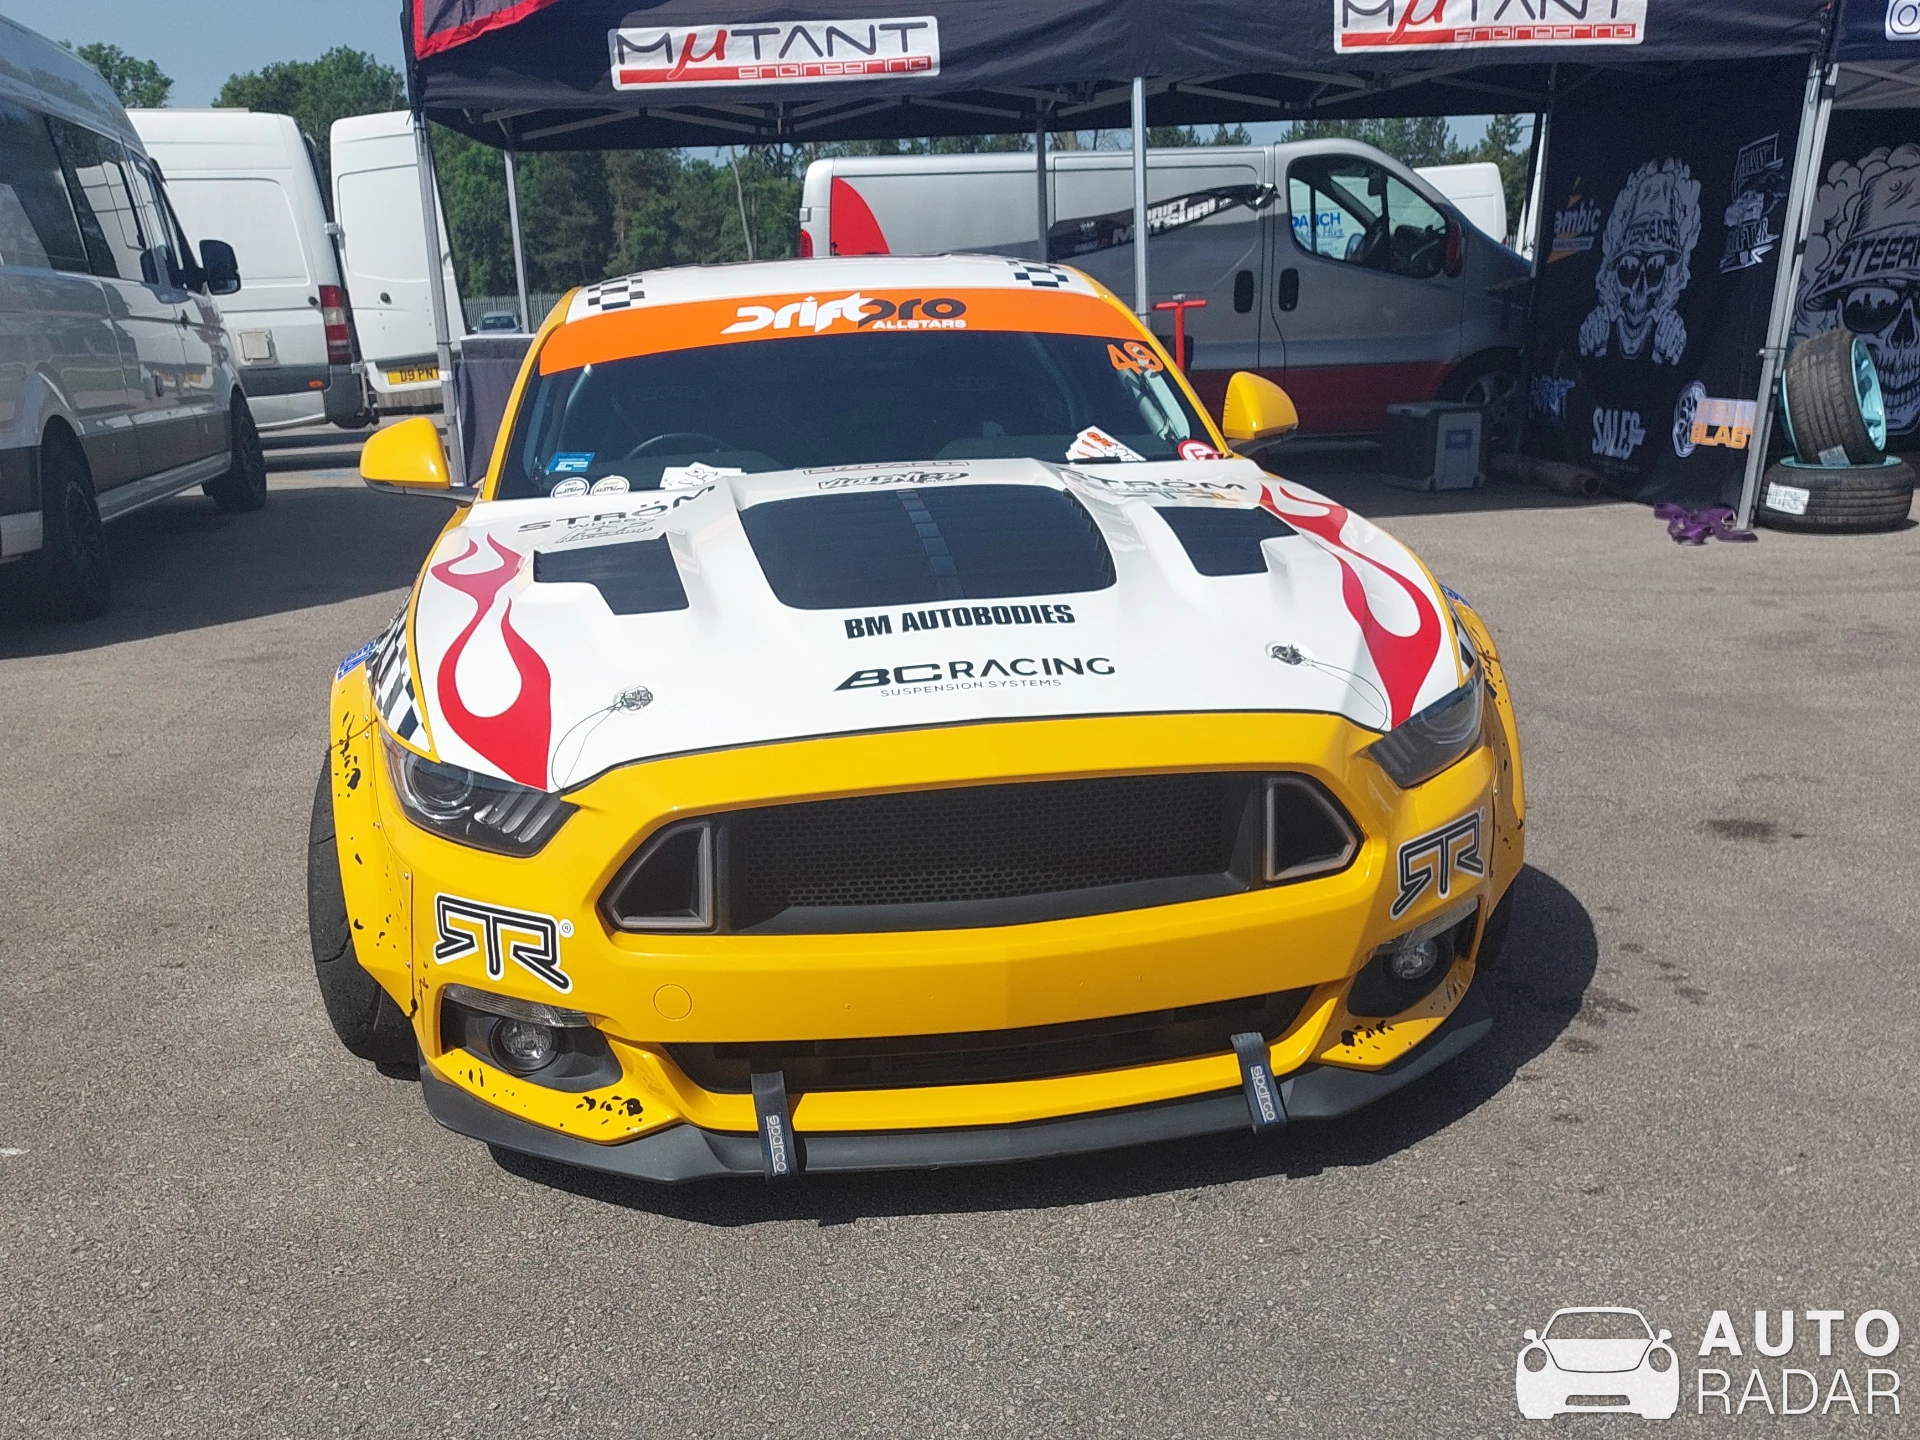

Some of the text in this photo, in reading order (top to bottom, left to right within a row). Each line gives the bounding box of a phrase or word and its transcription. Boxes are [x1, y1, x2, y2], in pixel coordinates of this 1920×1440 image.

[1112, 198, 1216, 245] MTSURI
[1146, 198, 1189, 221] RIFT
[1292, 212, 1340, 229] ACH
[1827, 236, 1920, 286] STEER
[872, 319, 967, 330] ALLSTARS
[1106, 342, 1164, 375] 49
[844, 604, 1076, 639] BM AUTOBODIES
[880, 679, 1062, 697] SUSPENSION SYSTEMS
[1251, 1066, 1276, 1122] sparco
[767, 1115, 787, 1173] sparco
